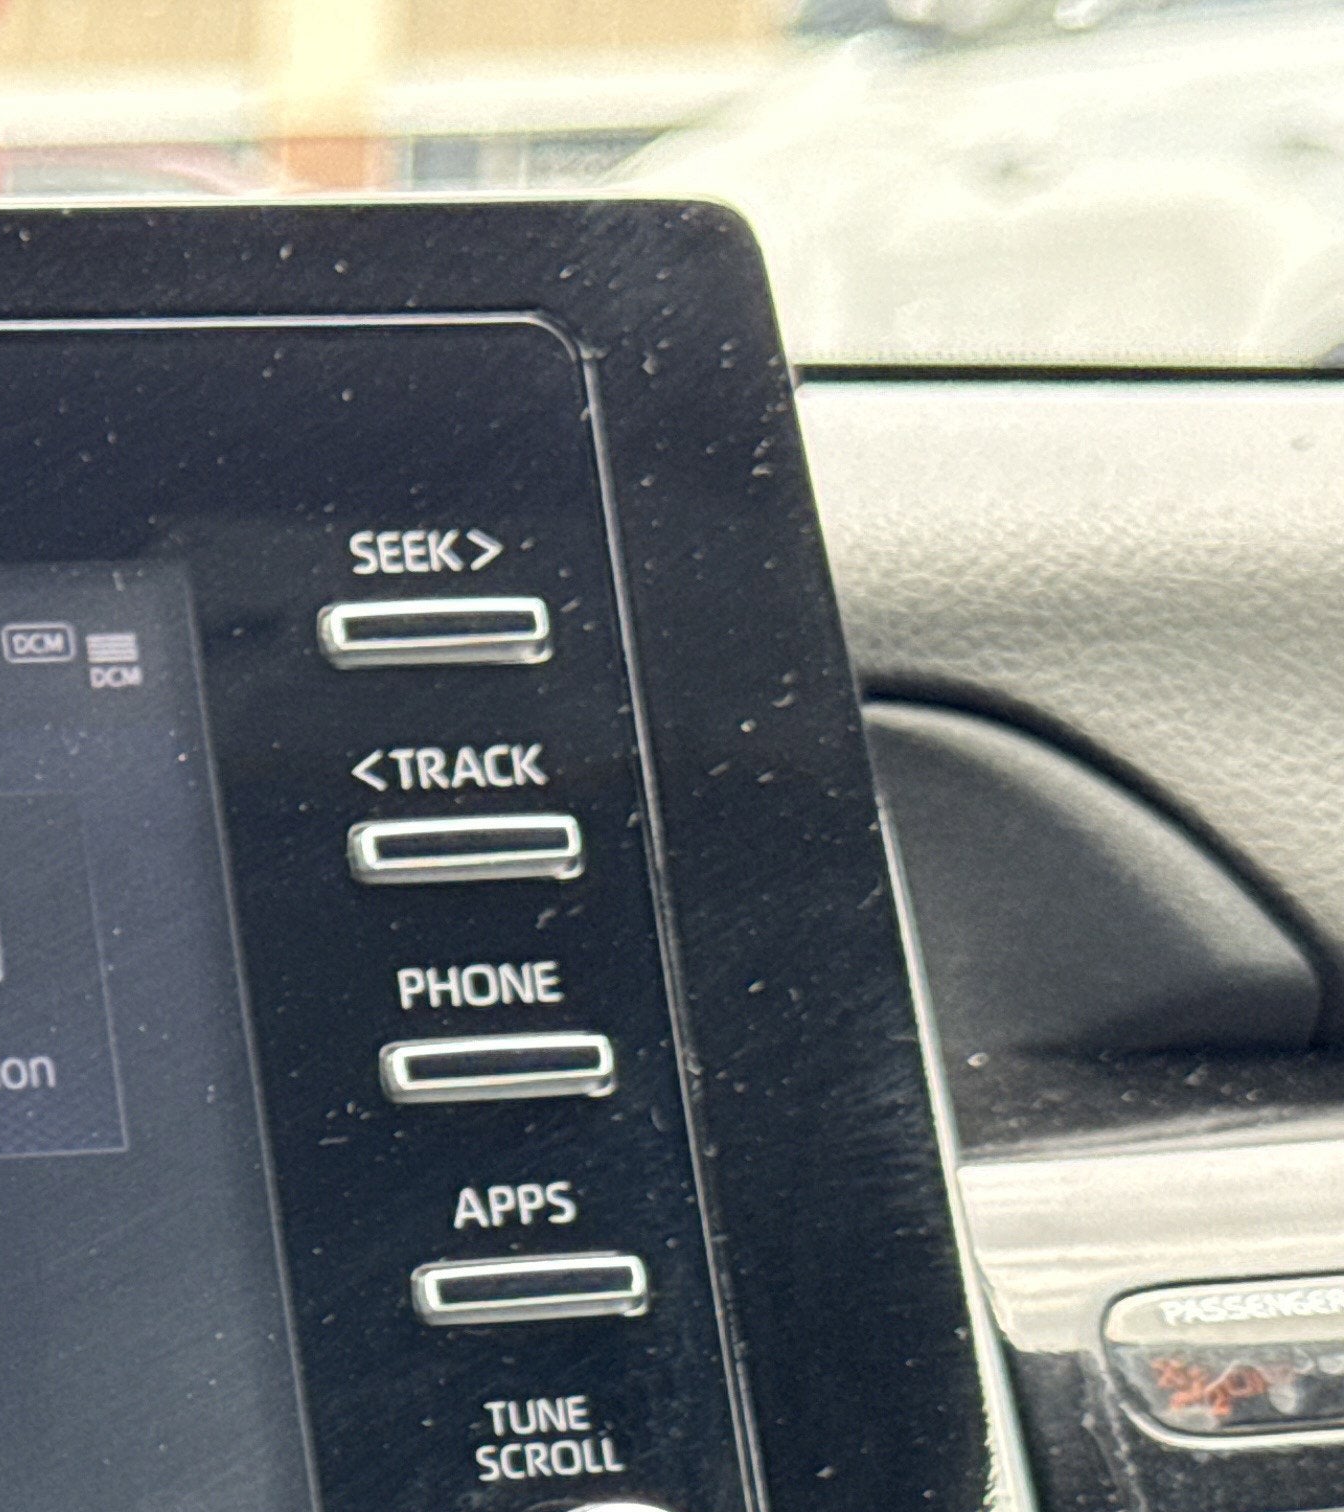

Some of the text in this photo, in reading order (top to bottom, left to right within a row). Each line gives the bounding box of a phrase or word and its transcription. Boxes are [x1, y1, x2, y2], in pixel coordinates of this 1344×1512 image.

[12, 632, 65, 655] DCM
[89, 665, 143, 689] DCM
[397, 960, 564, 1010] PHONE
[453, 1180, 578, 1230] APPS
[483, 1394, 592, 1438] TUNE
[474, 1436, 626, 1482] SCROLL
